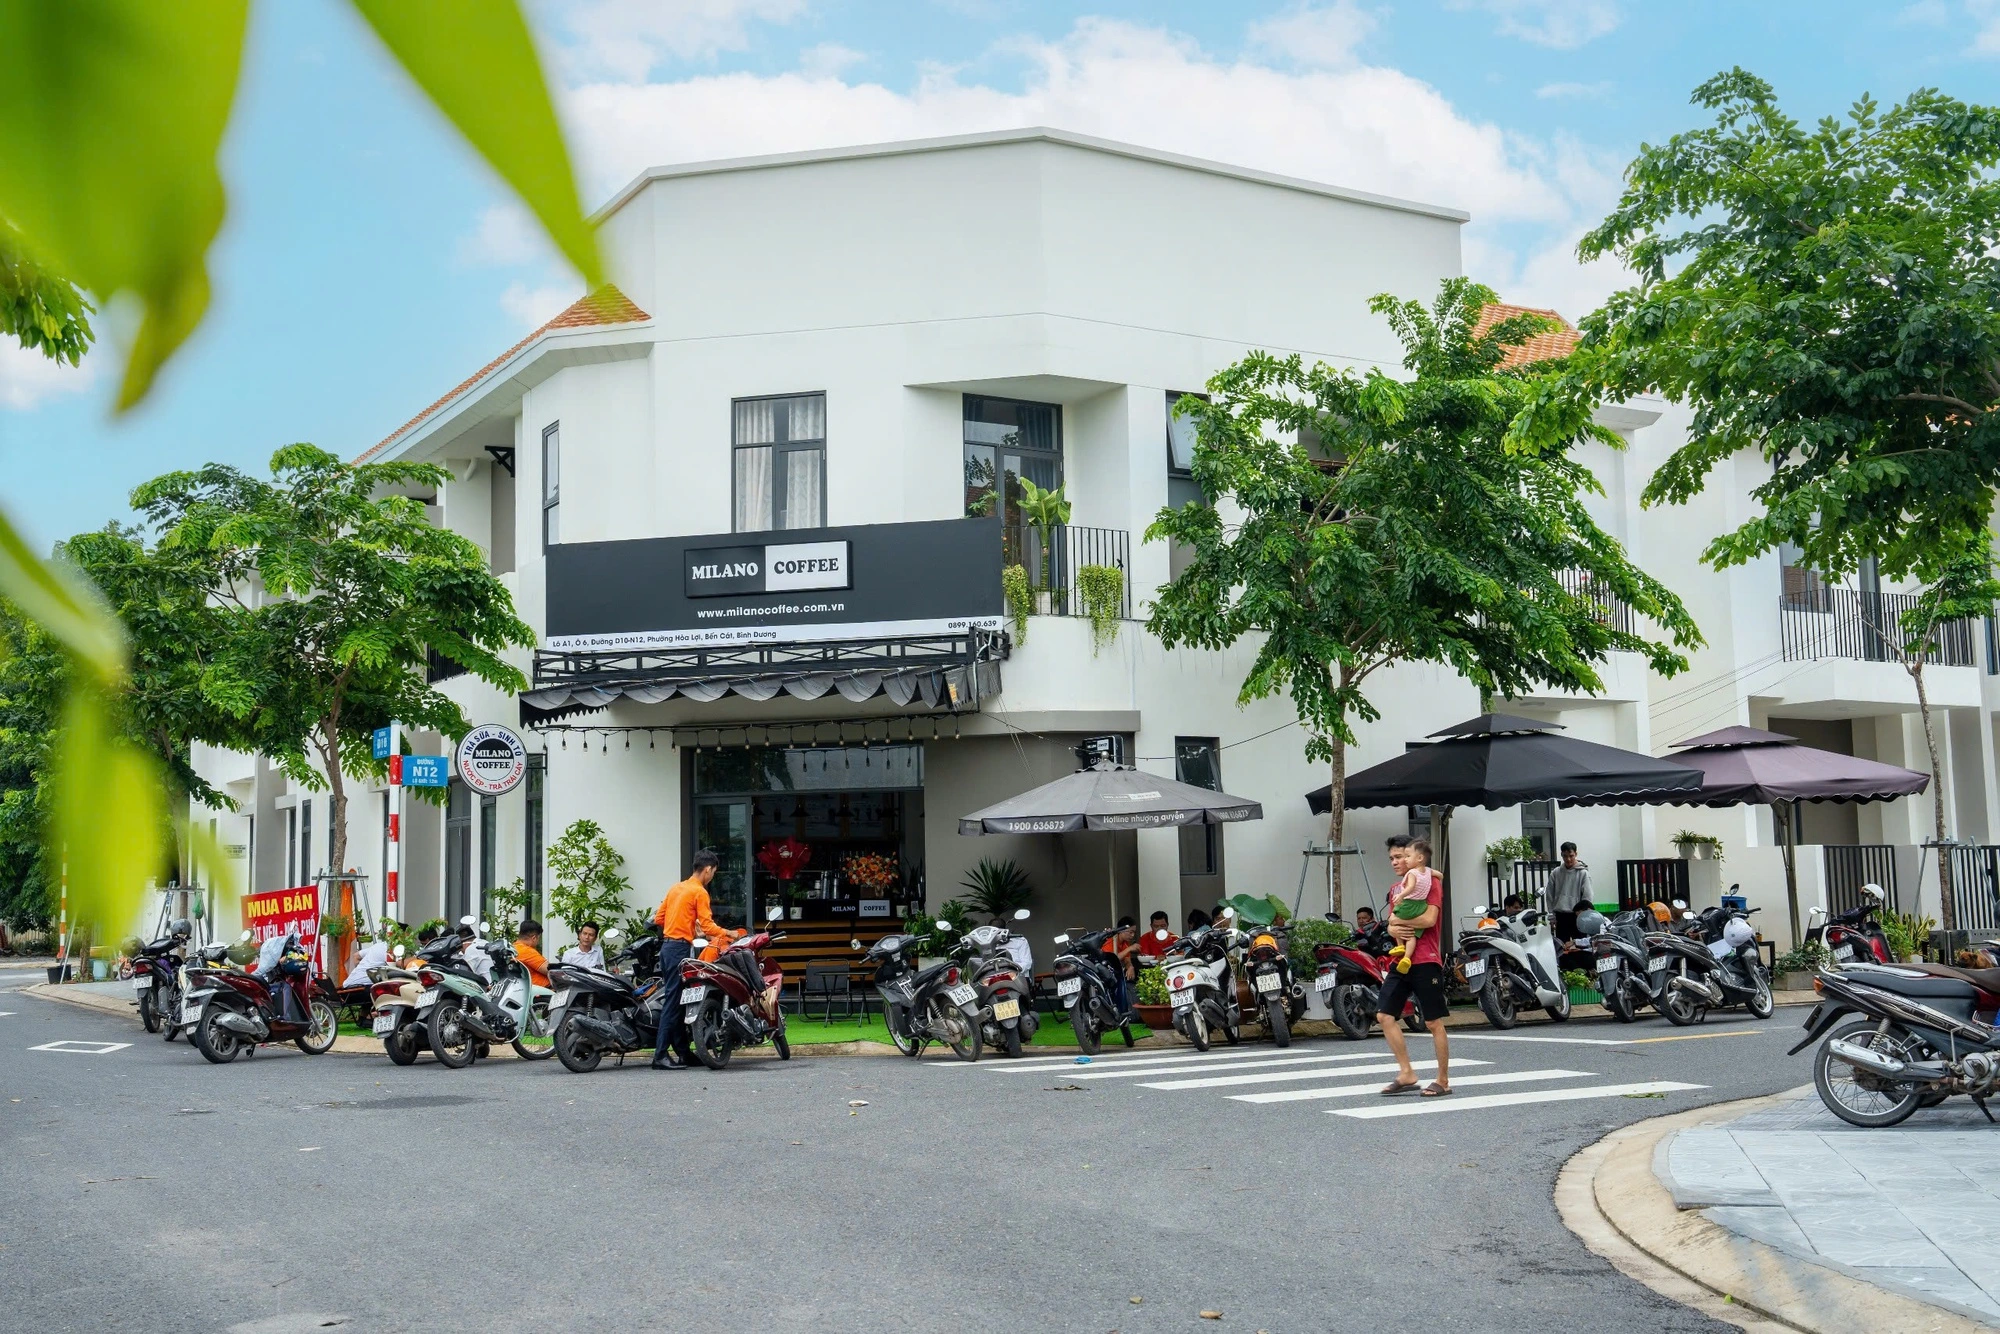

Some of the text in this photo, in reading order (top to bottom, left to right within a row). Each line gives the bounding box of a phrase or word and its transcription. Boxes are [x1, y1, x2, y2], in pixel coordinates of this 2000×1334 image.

[692, 558, 839, 580] MILANO COFFEE
[697, 603, 845, 618] www.milanocoffee.com.vn
[948, 620, 997, 628] 0899.160.639
[498, 731, 516, 746] SINH
[475, 749, 511, 757] MILANO
[476, 761, 511, 769] COFFEE
[412, 766, 438, 777] N12
[1103, 815, 1129, 823] Hotline
[1009, 821, 1065, 831] 1900 636873
[247, 891, 313, 918] MUA BÁN
[250, 920, 262, 943] ẤT
[300, 912, 315, 936] PHỐ
[956, 992, 974, 1004] 6077
